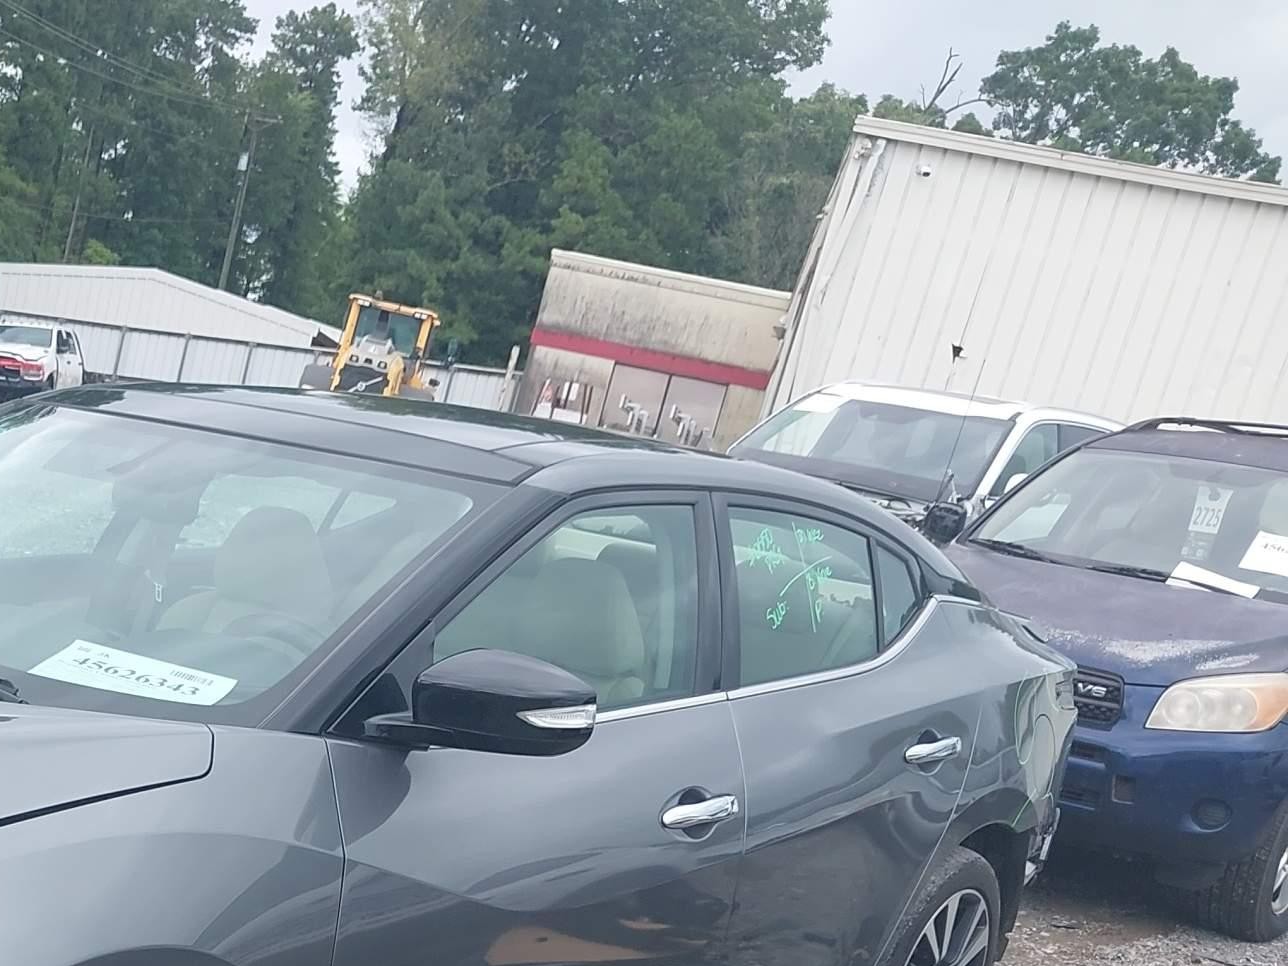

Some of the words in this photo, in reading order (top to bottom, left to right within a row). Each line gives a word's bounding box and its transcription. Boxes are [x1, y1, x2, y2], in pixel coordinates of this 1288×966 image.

[1192, 505, 1223, 528] 2725
[71, 656, 201, 696] 45626343
[1077, 682, 1108, 698] V6
